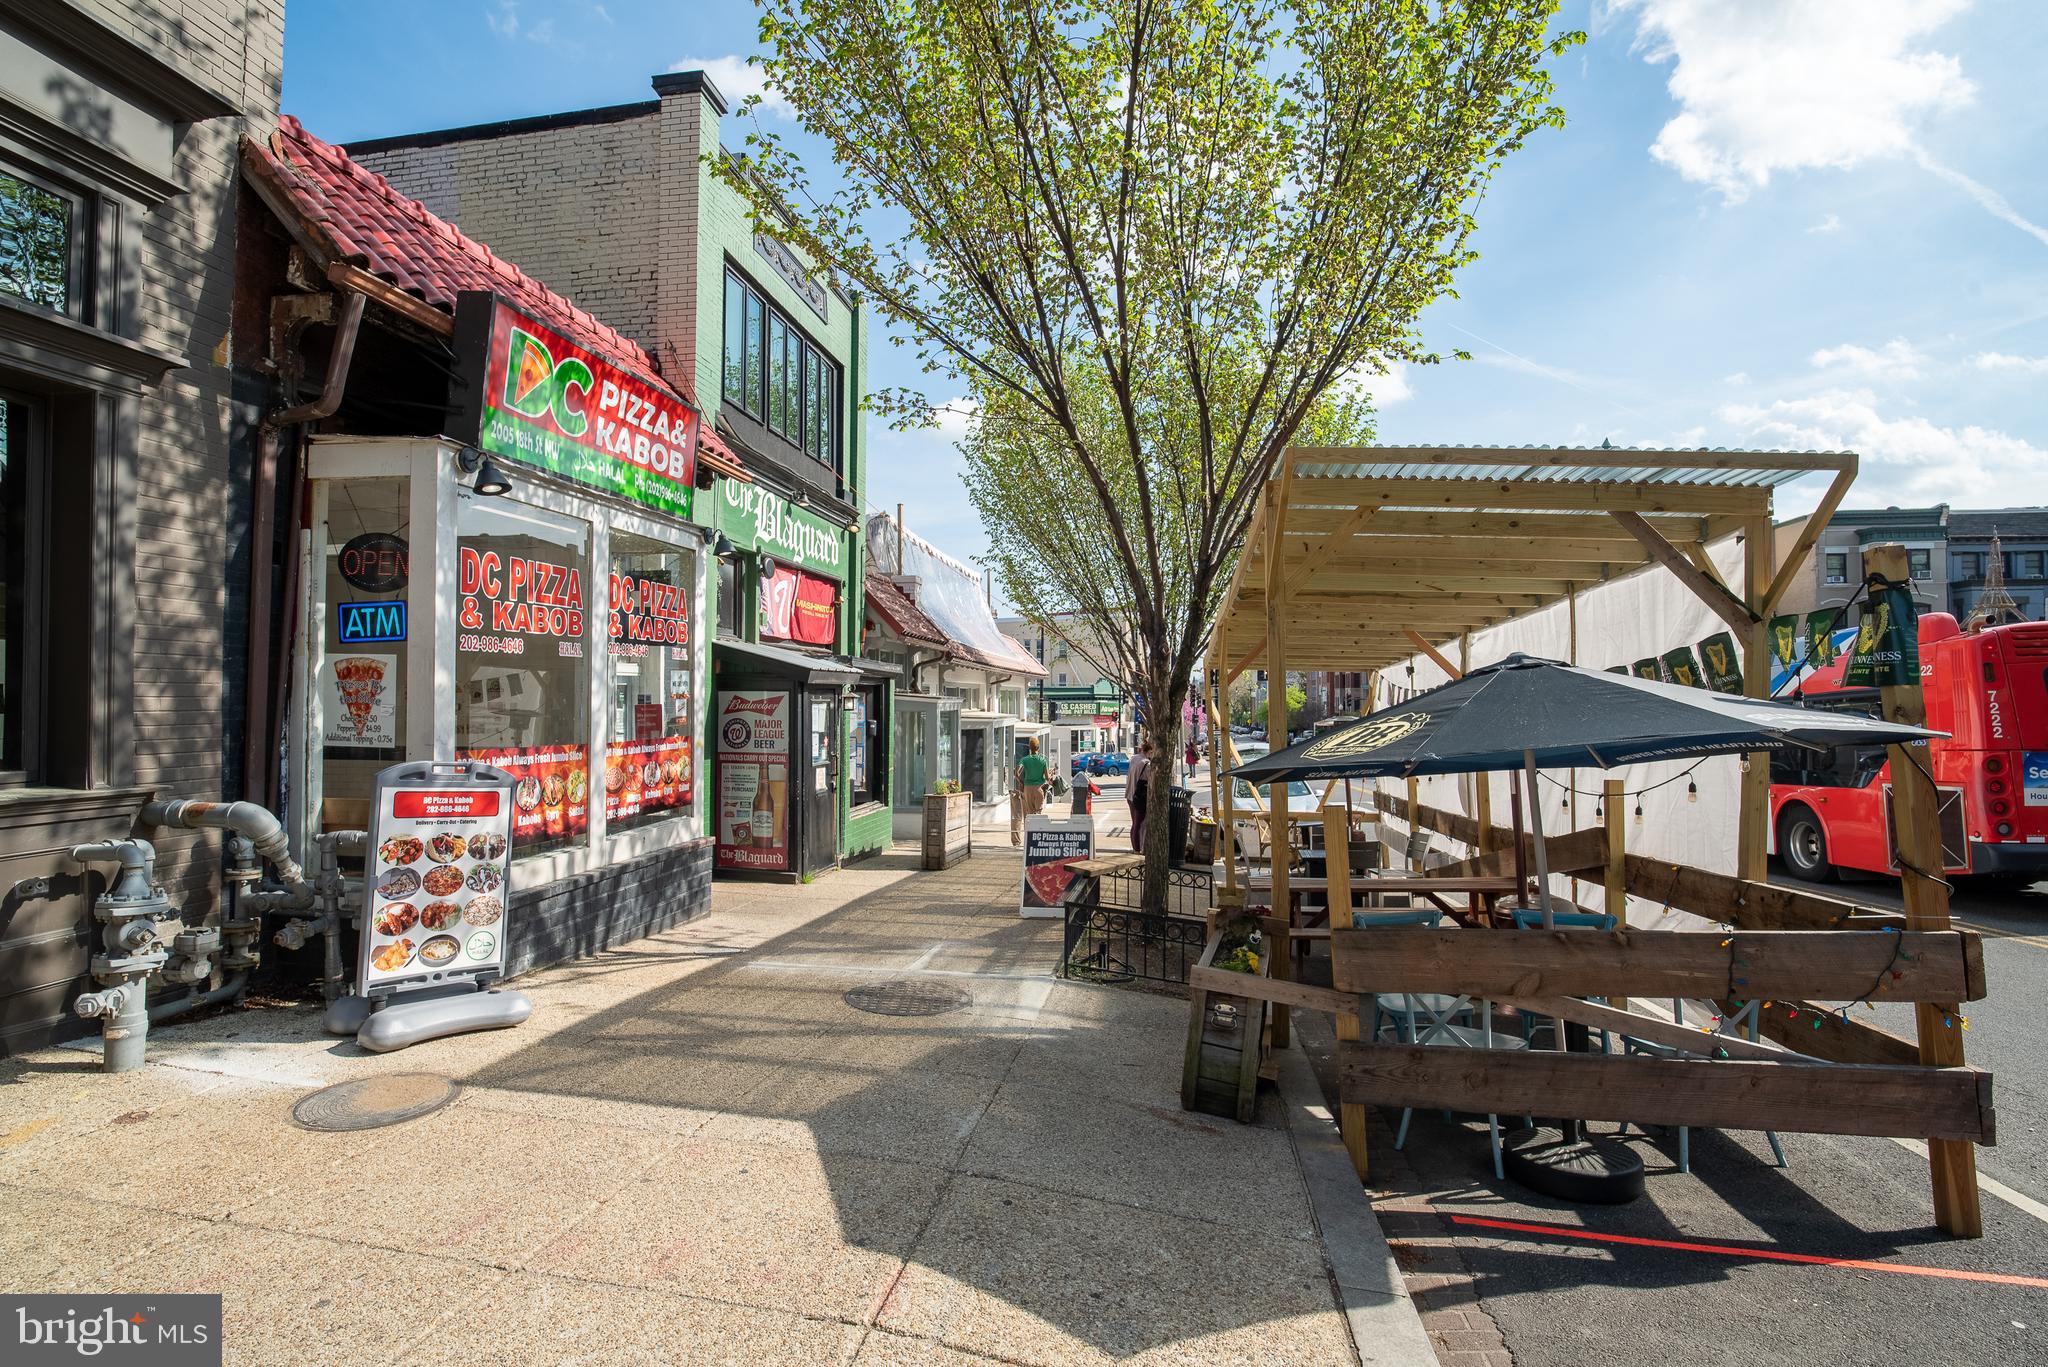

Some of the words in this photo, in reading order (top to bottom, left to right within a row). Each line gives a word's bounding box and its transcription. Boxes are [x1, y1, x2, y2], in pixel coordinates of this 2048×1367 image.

[504, 326, 594, 437] DC
[491, 420, 514, 445] 2005
[516, 429, 533, 450] 18th
[535, 436, 543, 454] St
[544, 438, 560, 461] NW
[596, 416, 684, 479] KABOB
[598, 462, 626, 484] HALAL
[725, 476, 753, 518] The
[753, 486, 839, 567] Blaguard
[343, 549, 409, 576] OPEN
[460, 546, 501, 599] DC
[509, 556, 583, 610] PIZZA
[609, 573, 635, 614] DC
[640, 579, 688, 622] PIZZA
[345, 606, 401, 637] ATM
[460, 596, 484, 629] &
[493, 600, 583, 637] KABOB
[608, 612, 623, 638] &
[629, 614, 688, 644] KABOB
[460, 634, 524, 654] 202-986-4646
[559, 641, 583, 657] HALAL
[608, 642, 649, 657] 202-986-4646
[729, 699, 780, 710] Budweiser
[1987, 690, 2003, 738] 7222
[754, 719, 783, 729] MAJOR
[353, 733, 373, 744] Topping
[754, 729, 785, 739] LEAGUE
[754, 739, 775, 749] BEER
[1665, 746, 1688, 754] THE
[1704, 741, 1784, 751] HEARTLAND
[491, 756, 512, 767] Kabob
[513, 754, 535, 765] Always
[535, 752, 550, 764] Fresh
[551, 752, 568, 762] Jumbo
[568, 751, 583, 761] Slice
[2029, 766, 2048, 779] Se
[433, 796, 448, 804] Pizza
[454, 796, 473, 804] Kabob
[2030, 792, 2048, 800] Hou
[518, 814, 541, 826] Kabobs
[545, 810, 560, 822] Gyro
[568, 807, 584, 817] Salad
[1032, 832, 1042, 841] DC
[1042, 833, 1058, 841] Pizza
[1059, 833, 1064, 841] &
[1065, 833, 1087, 841] Kabob
[720, 849, 734, 858] The
[734, 849, 784, 865] Blaguard
[1029, 847, 1061, 857] Jumbo
[1063, 847, 1088, 857] Slice
